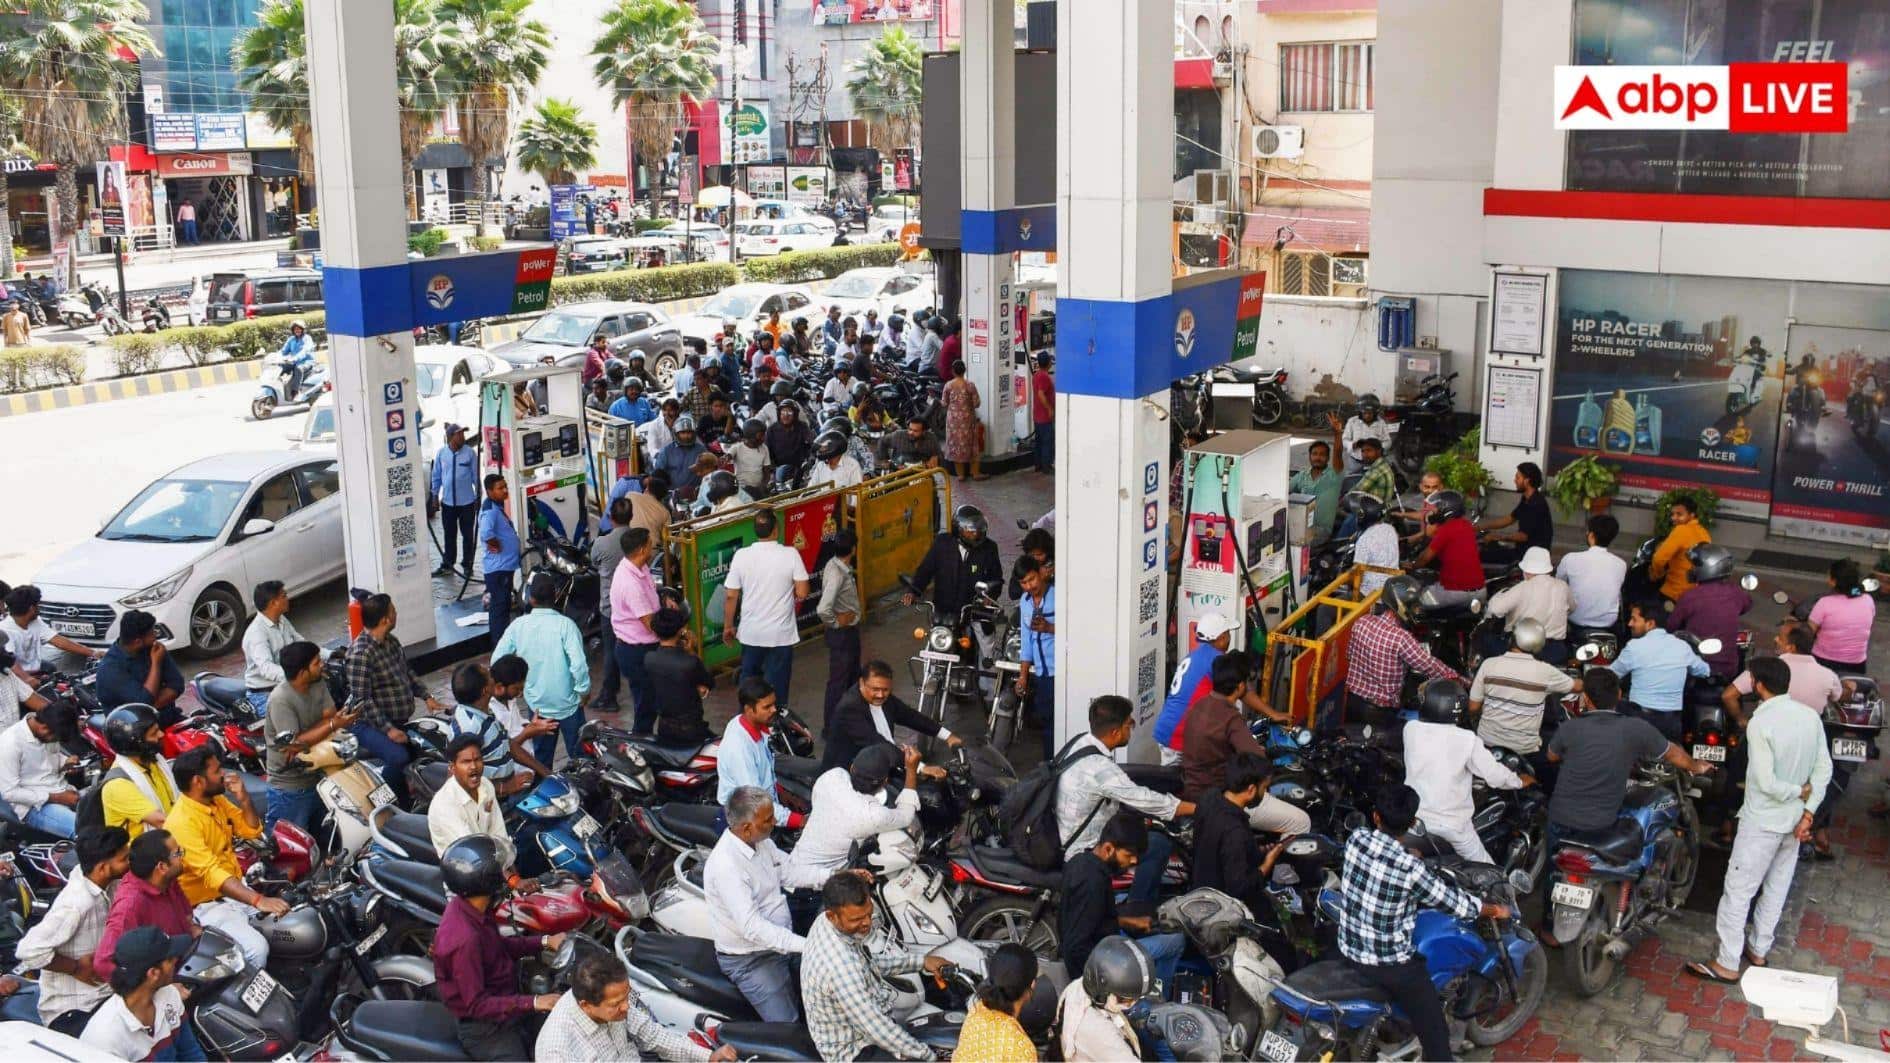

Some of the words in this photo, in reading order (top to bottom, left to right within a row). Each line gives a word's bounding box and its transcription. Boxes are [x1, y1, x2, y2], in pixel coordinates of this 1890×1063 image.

[1773, 40, 1835, 62] FEEL
[173, 158, 216, 169] Canon
[434, 279, 448, 291] HP
[517, 289, 545, 306] Petrol
[1181, 315, 1192, 330] HP
[1572, 318, 1596, 334] HP
[1601, 320, 1661, 338] RACER
[1237, 327, 1256, 347] Petrol
[1571, 334, 1592, 344] FOR
[1595, 335, 1614, 346] THE
[1616, 337, 1643, 348] NEXT
[1646, 339, 1714, 354] GENERATION
[1571, 344, 1635, 358] 2-WHEELERS
[1698, 449, 1737, 463] RACER
[1792, 476, 1835, 492] POWER
[1845, 481, 1883, 497] THRILL
[1196, 561, 1224, 572] CLUB
